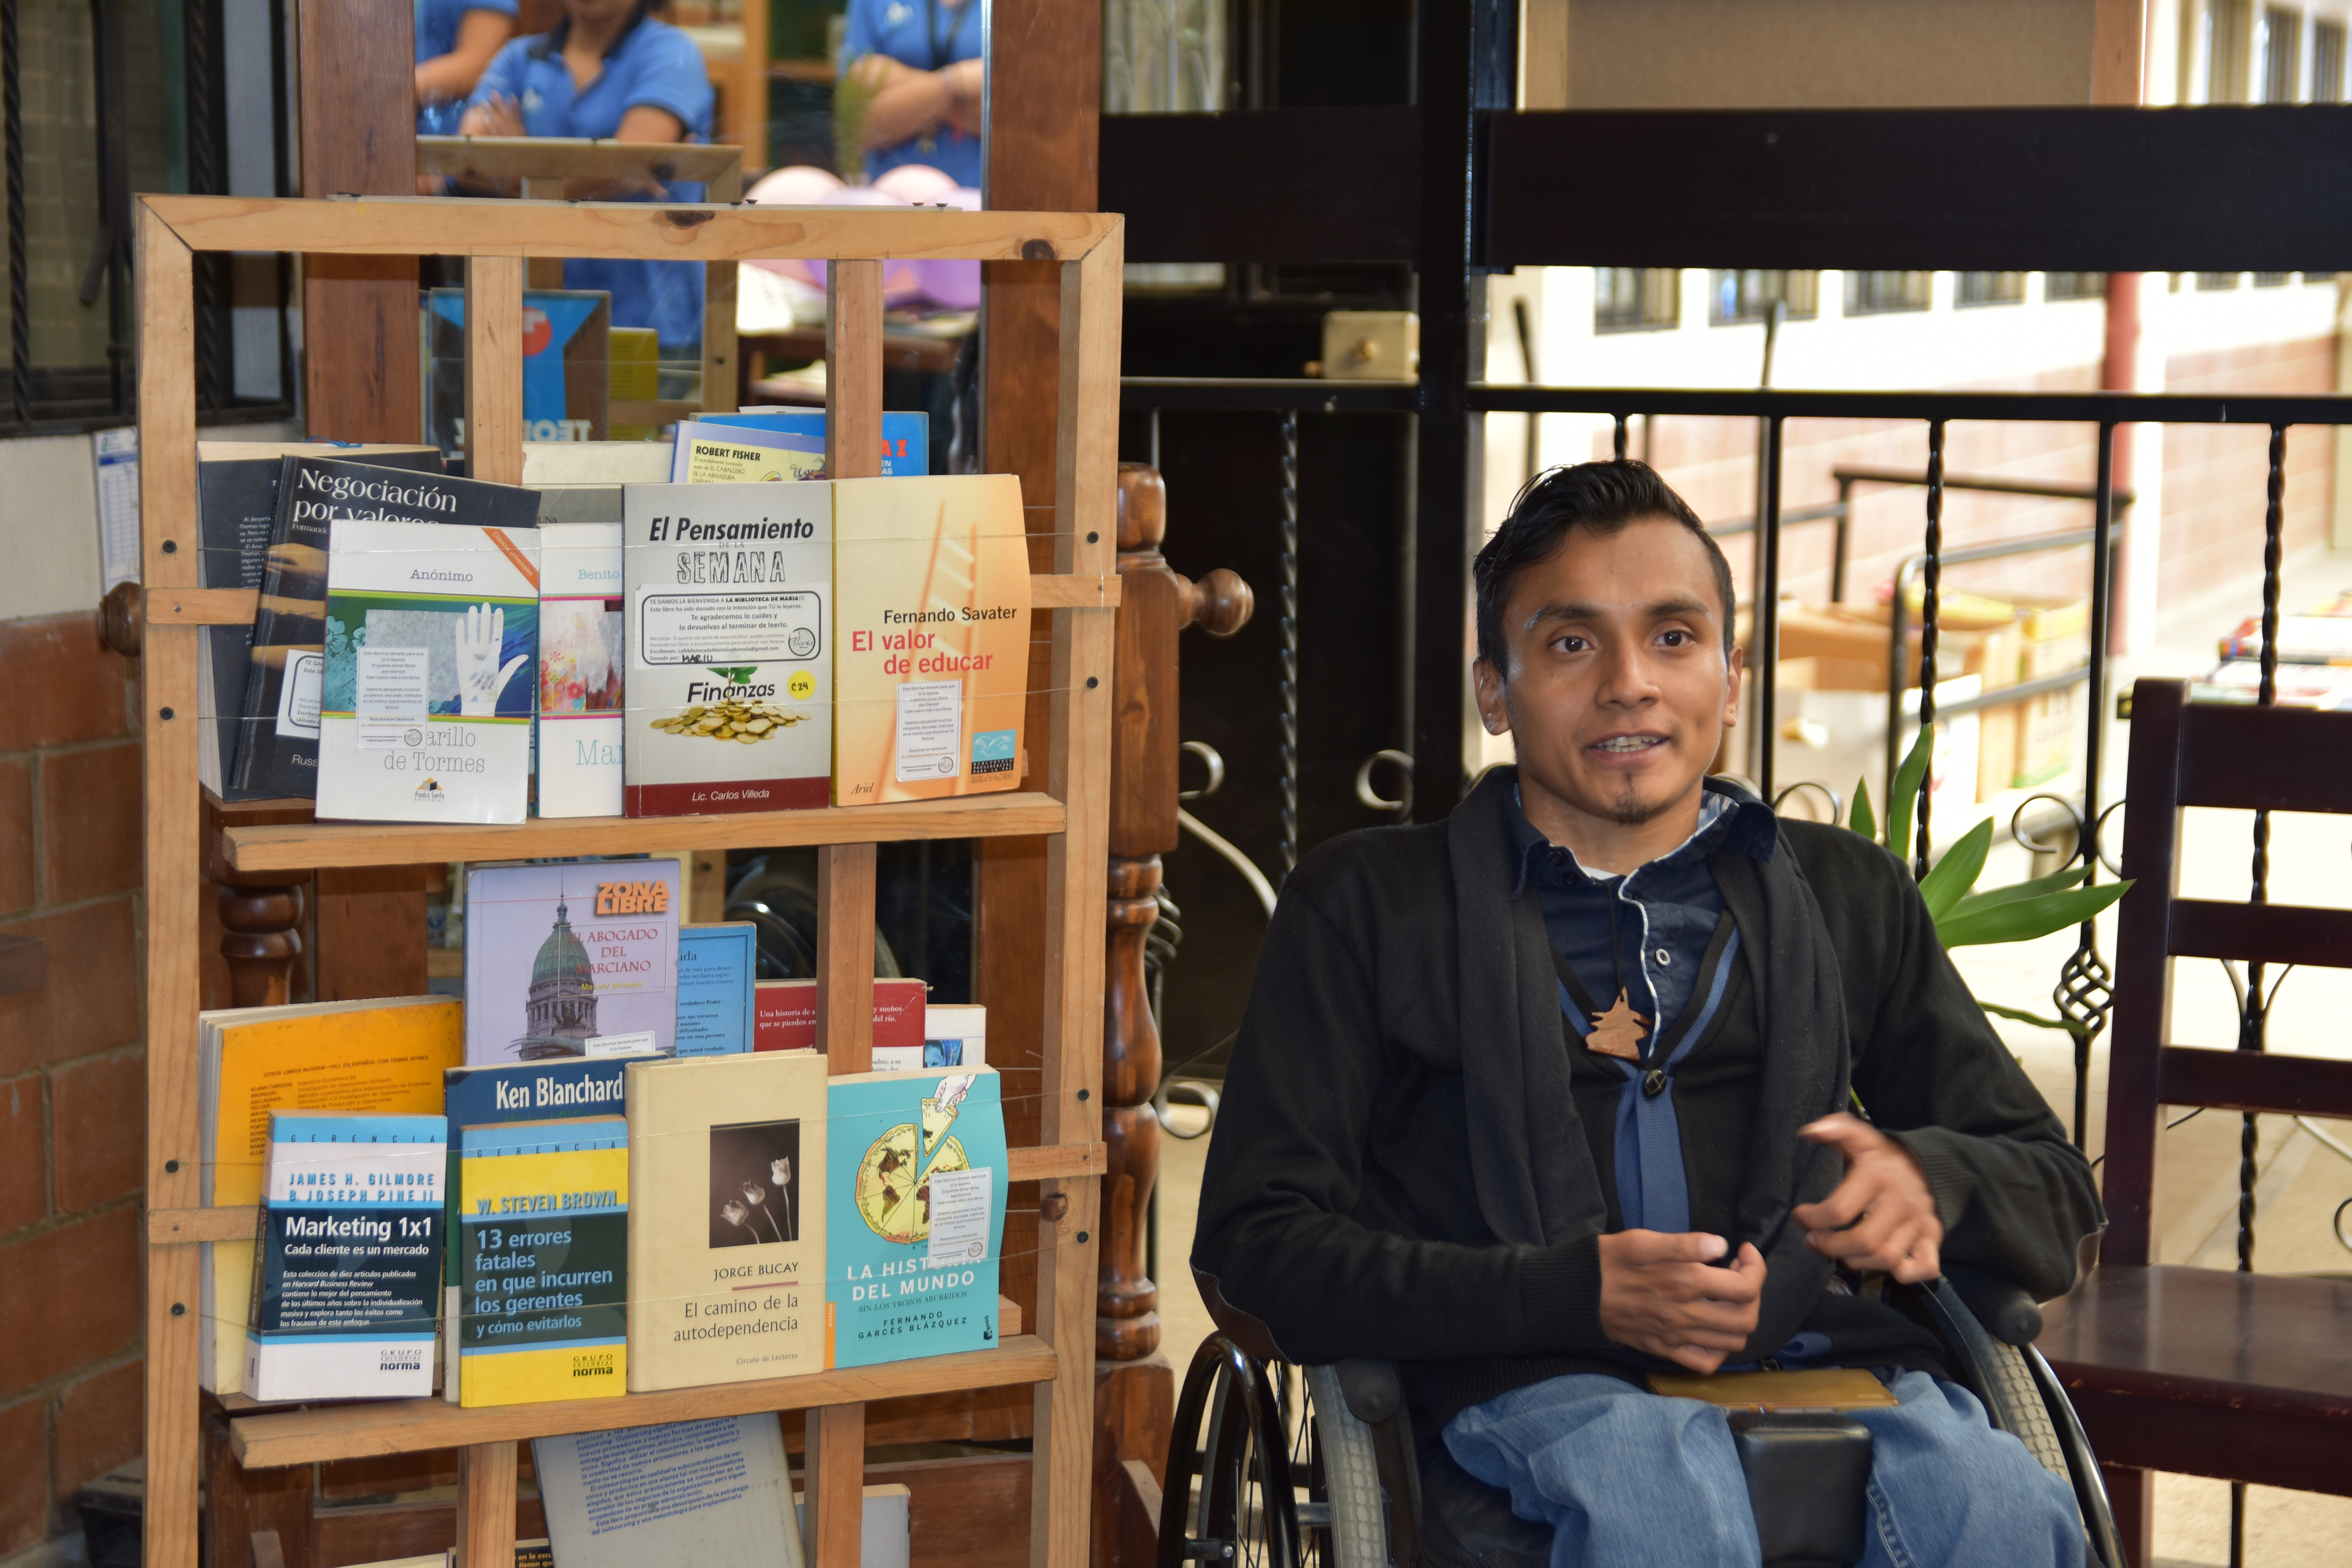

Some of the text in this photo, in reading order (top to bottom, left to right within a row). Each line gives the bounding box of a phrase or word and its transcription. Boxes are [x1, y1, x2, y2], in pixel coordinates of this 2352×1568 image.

[695, 445, 761, 461] ROBERT FISHER
[897, 439, 907, 456] Z
[298, 468, 457, 512] Negociación
[293, 500, 338, 523] por
[649, 516, 814, 541] El Pensamiento
[493, 531, 533, 576] Clásicos universales
[410, 569, 473, 582] Anónimo
[578, 569, 620, 580] Benito
[677, 551, 786, 584] SEMANA
[885, 607, 1016, 623] Fernando Savater
[853, 629, 935, 651] El valor
[884, 652, 993, 675] de educar
[687, 682, 775, 703] Finanzas
[791, 682, 809, 691] C24
[427, 726, 475, 747] arillo
[385, 750, 485, 772] de Tormes
[692, 789, 769, 801] Lic. Carlos Villeda
[851, 782, 874, 794] Ariel
[599, 880, 669, 897] ZONA
[597, 895, 669, 915] LIBRE
[570, 929, 658, 943] EL ABOGADO
[601, 946, 626, 957] DEL
[575, 960, 652, 975] MARCIANO
[782, 1019, 806, 1027] pierden
[496, 1071, 623, 1109] Ken Blanchard
[291, 1134, 435, 1143] GERENCIA
[477, 1141, 616, 1158] GERENCIA
[290, 1173, 434, 1185] JAMES H. GILMORE
[289, 1189, 433, 1202] B. JOSEPH PINE II
[477, 1189, 617, 1215] W. STEVEN BROWN
[286, 1216, 431, 1241] Marketing 1x1
[478, 1229, 571, 1249] 13 errores
[285, 1244, 312, 1255] Cada
[314, 1244, 350, 1254] cliente
[383, 1245, 429, 1255] mercado
[475, 1251, 536, 1271] fatales
[714, 1262, 798, 1280] JORGE BUCAY
[848, 1257, 981, 1281] LA HIST
[475, 1270, 613, 1295] en que incurren
[853, 1271, 974, 1300] DEL MUNDO
[475, 1292, 583, 1315] los gerentes
[686, 1294, 797, 1318] El camino de la
[892, 1298, 922, 1308] TROZOS
[924, 1290, 967, 1301] ABURRIDOS
[477, 1316, 582, 1338] y cómo evitarlos
[858, 1317, 966, 1338] GARCÉS BLÁZQUEZ
[883, 1311, 943, 1326] FERNANDO
[984, 1315, 993, 1338] booket
[674, 1316, 798, 1342] autodependencia
[380, 1362, 421, 1370] norma
[573, 1366, 613, 1376] norma
[602, 1520, 635, 1533] outsourcing
[653, 1507, 688, 1520] metodología
[689, 1504, 702, 1512] para
[702, 1494, 743, 1508] implementarla.
